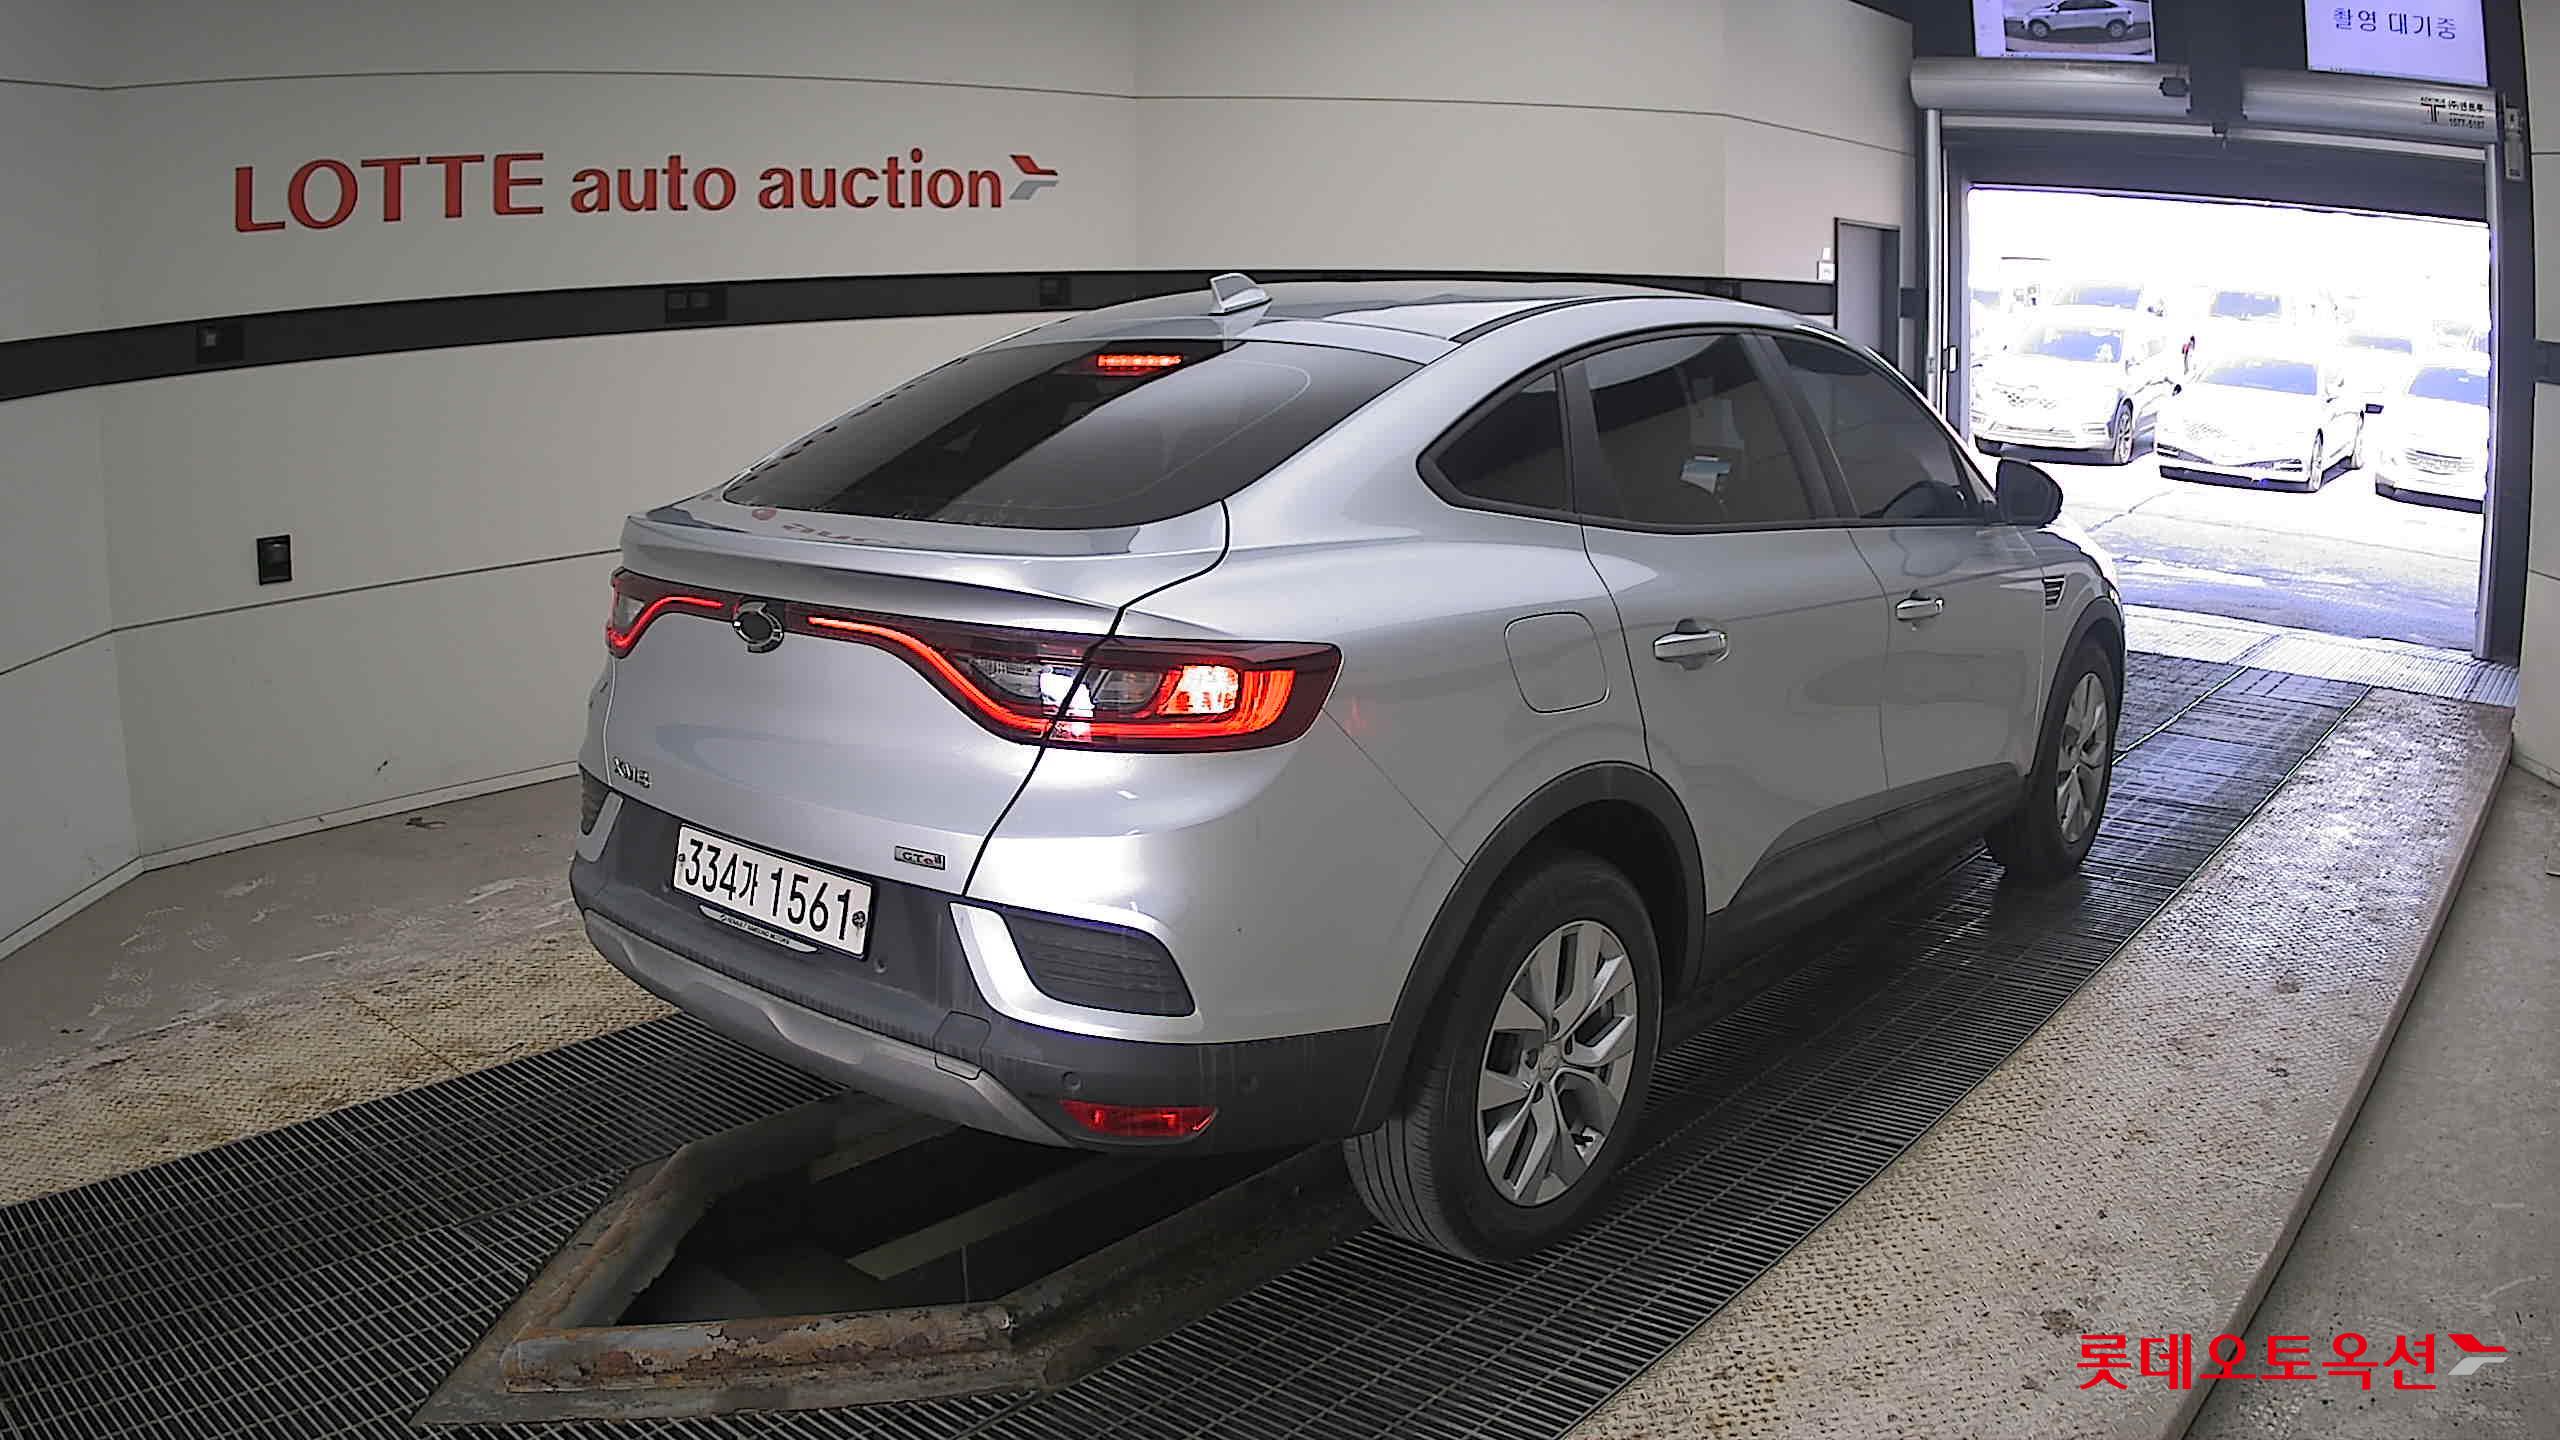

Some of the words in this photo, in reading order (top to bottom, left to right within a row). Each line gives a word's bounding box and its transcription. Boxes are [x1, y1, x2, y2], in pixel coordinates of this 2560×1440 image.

[2333, 7, 2377, 32] 촬영
[2388, 11, 2457, 40] 대기중
[235, 152, 544, 233] LOTTE
[570, 154, 737, 215] auto
[758, 147, 1002, 210] auction
[685, 838, 759, 906] 334가
[771, 867, 851, 940] 1561
